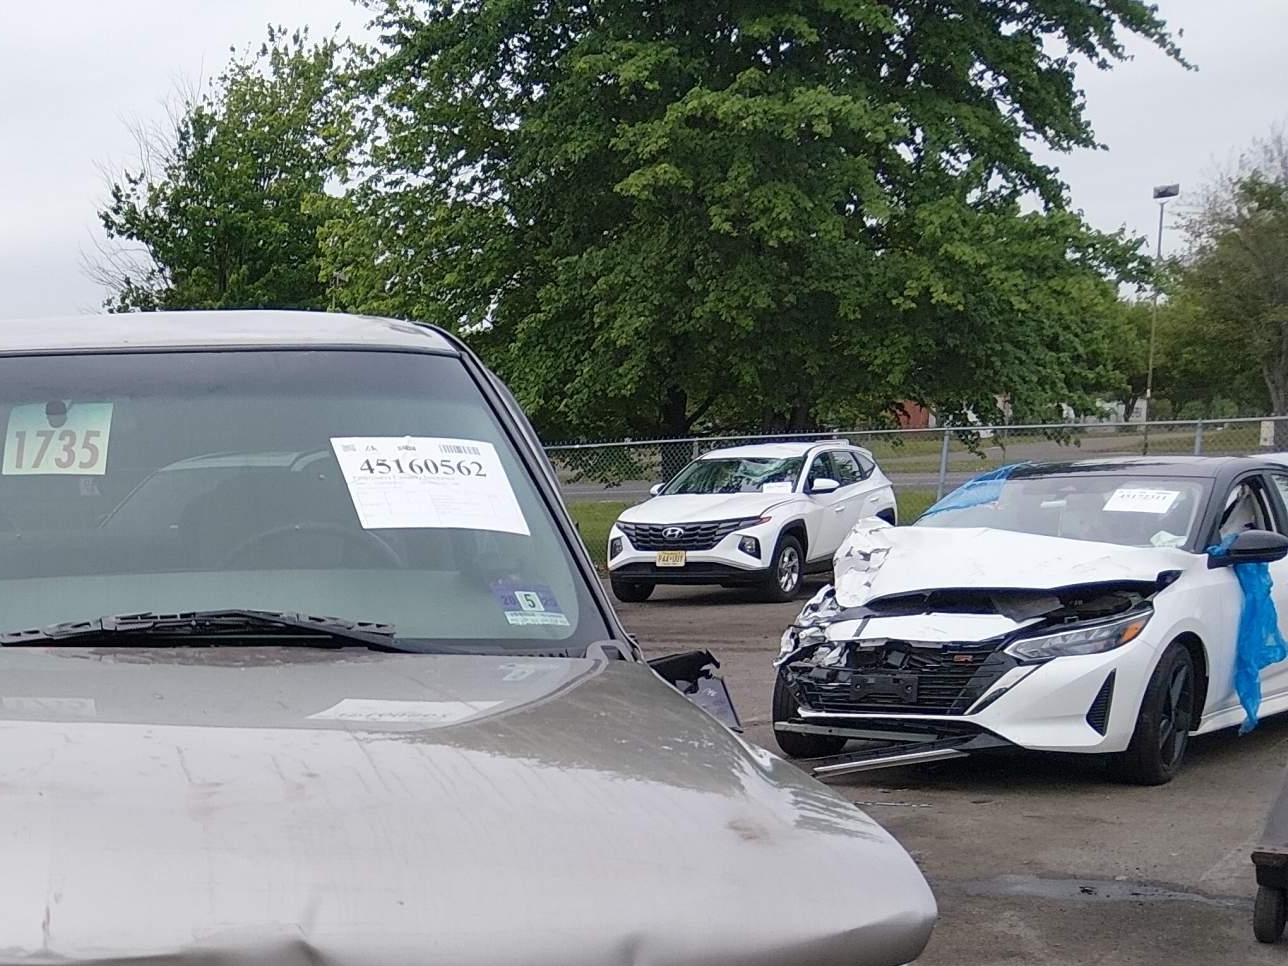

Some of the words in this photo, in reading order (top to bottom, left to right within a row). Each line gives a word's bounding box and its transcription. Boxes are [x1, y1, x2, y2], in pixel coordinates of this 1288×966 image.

[15, 430, 101, 469] 1735
[359, 458, 488, 477] 45160562
[523, 593, 536, 608] 5
